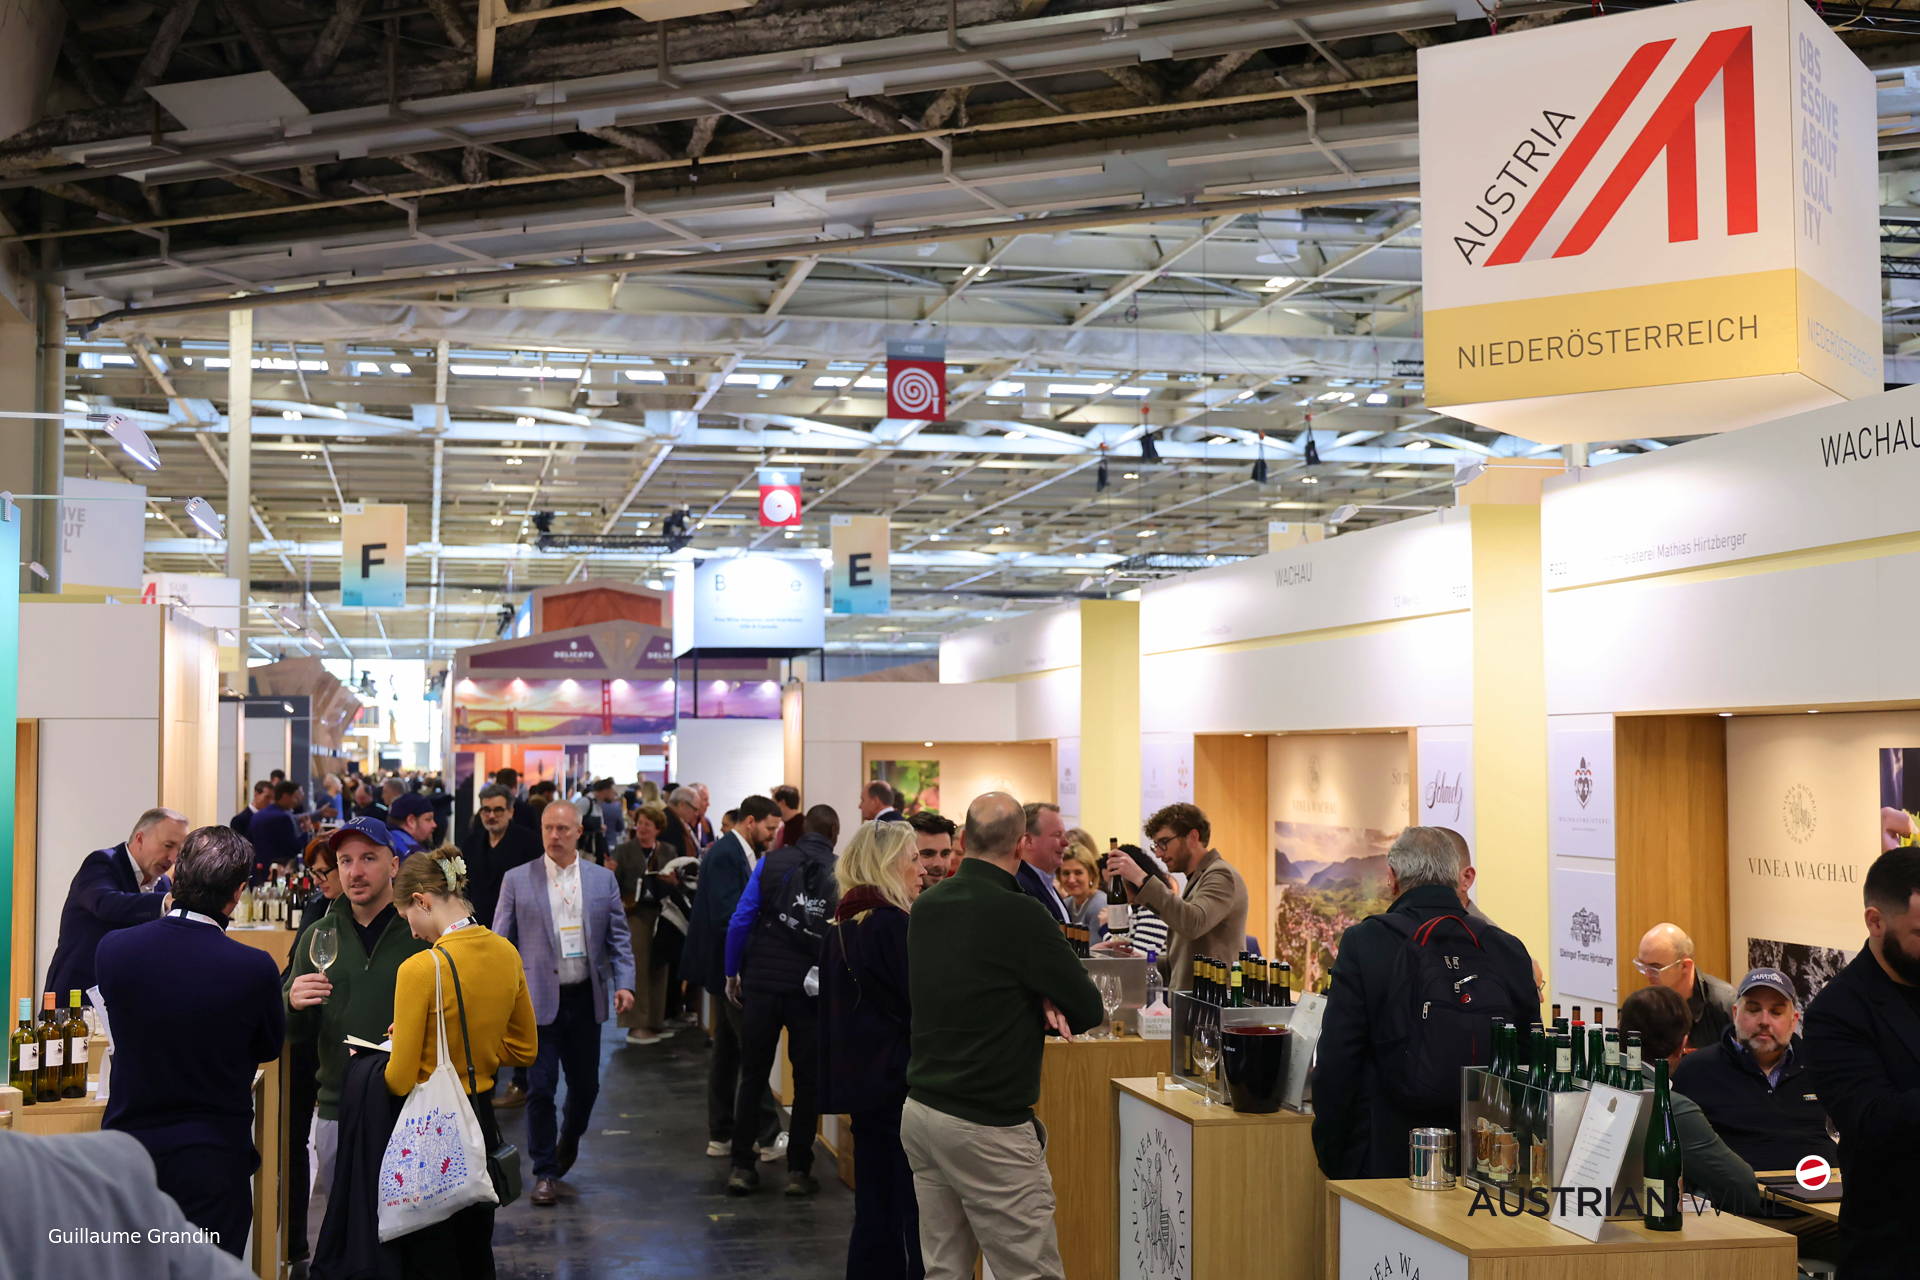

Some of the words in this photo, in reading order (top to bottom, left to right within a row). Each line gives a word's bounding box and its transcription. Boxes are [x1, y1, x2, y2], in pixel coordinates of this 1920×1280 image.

[1799, 32, 1822, 84] OBS
[1800, 72, 1839, 141] ESSIVE
[1801, 117, 1838, 178] ABOUT
[1453, 108, 1576, 266] AUSTRIA
[1802, 158, 1832, 215] QUAL
[1803, 200, 1822, 246] ITY
[1458, 314, 1759, 369] NIEDERÖSTERREICH
[361, 542, 387, 579] F
[1693, 532, 1748, 553] Hirtzberger
[848, 553, 873, 587] E
[1274, 562, 1313, 588] WACHAU
[553, 651, 594, 659] DELICATO
[1748, 857, 1790, 878] VINEA
[1793, 860, 1859, 884] WACHAU
[1132, 1131, 1152, 1192] VINEA
[1154, 1128, 1186, 1225] WACHAU
